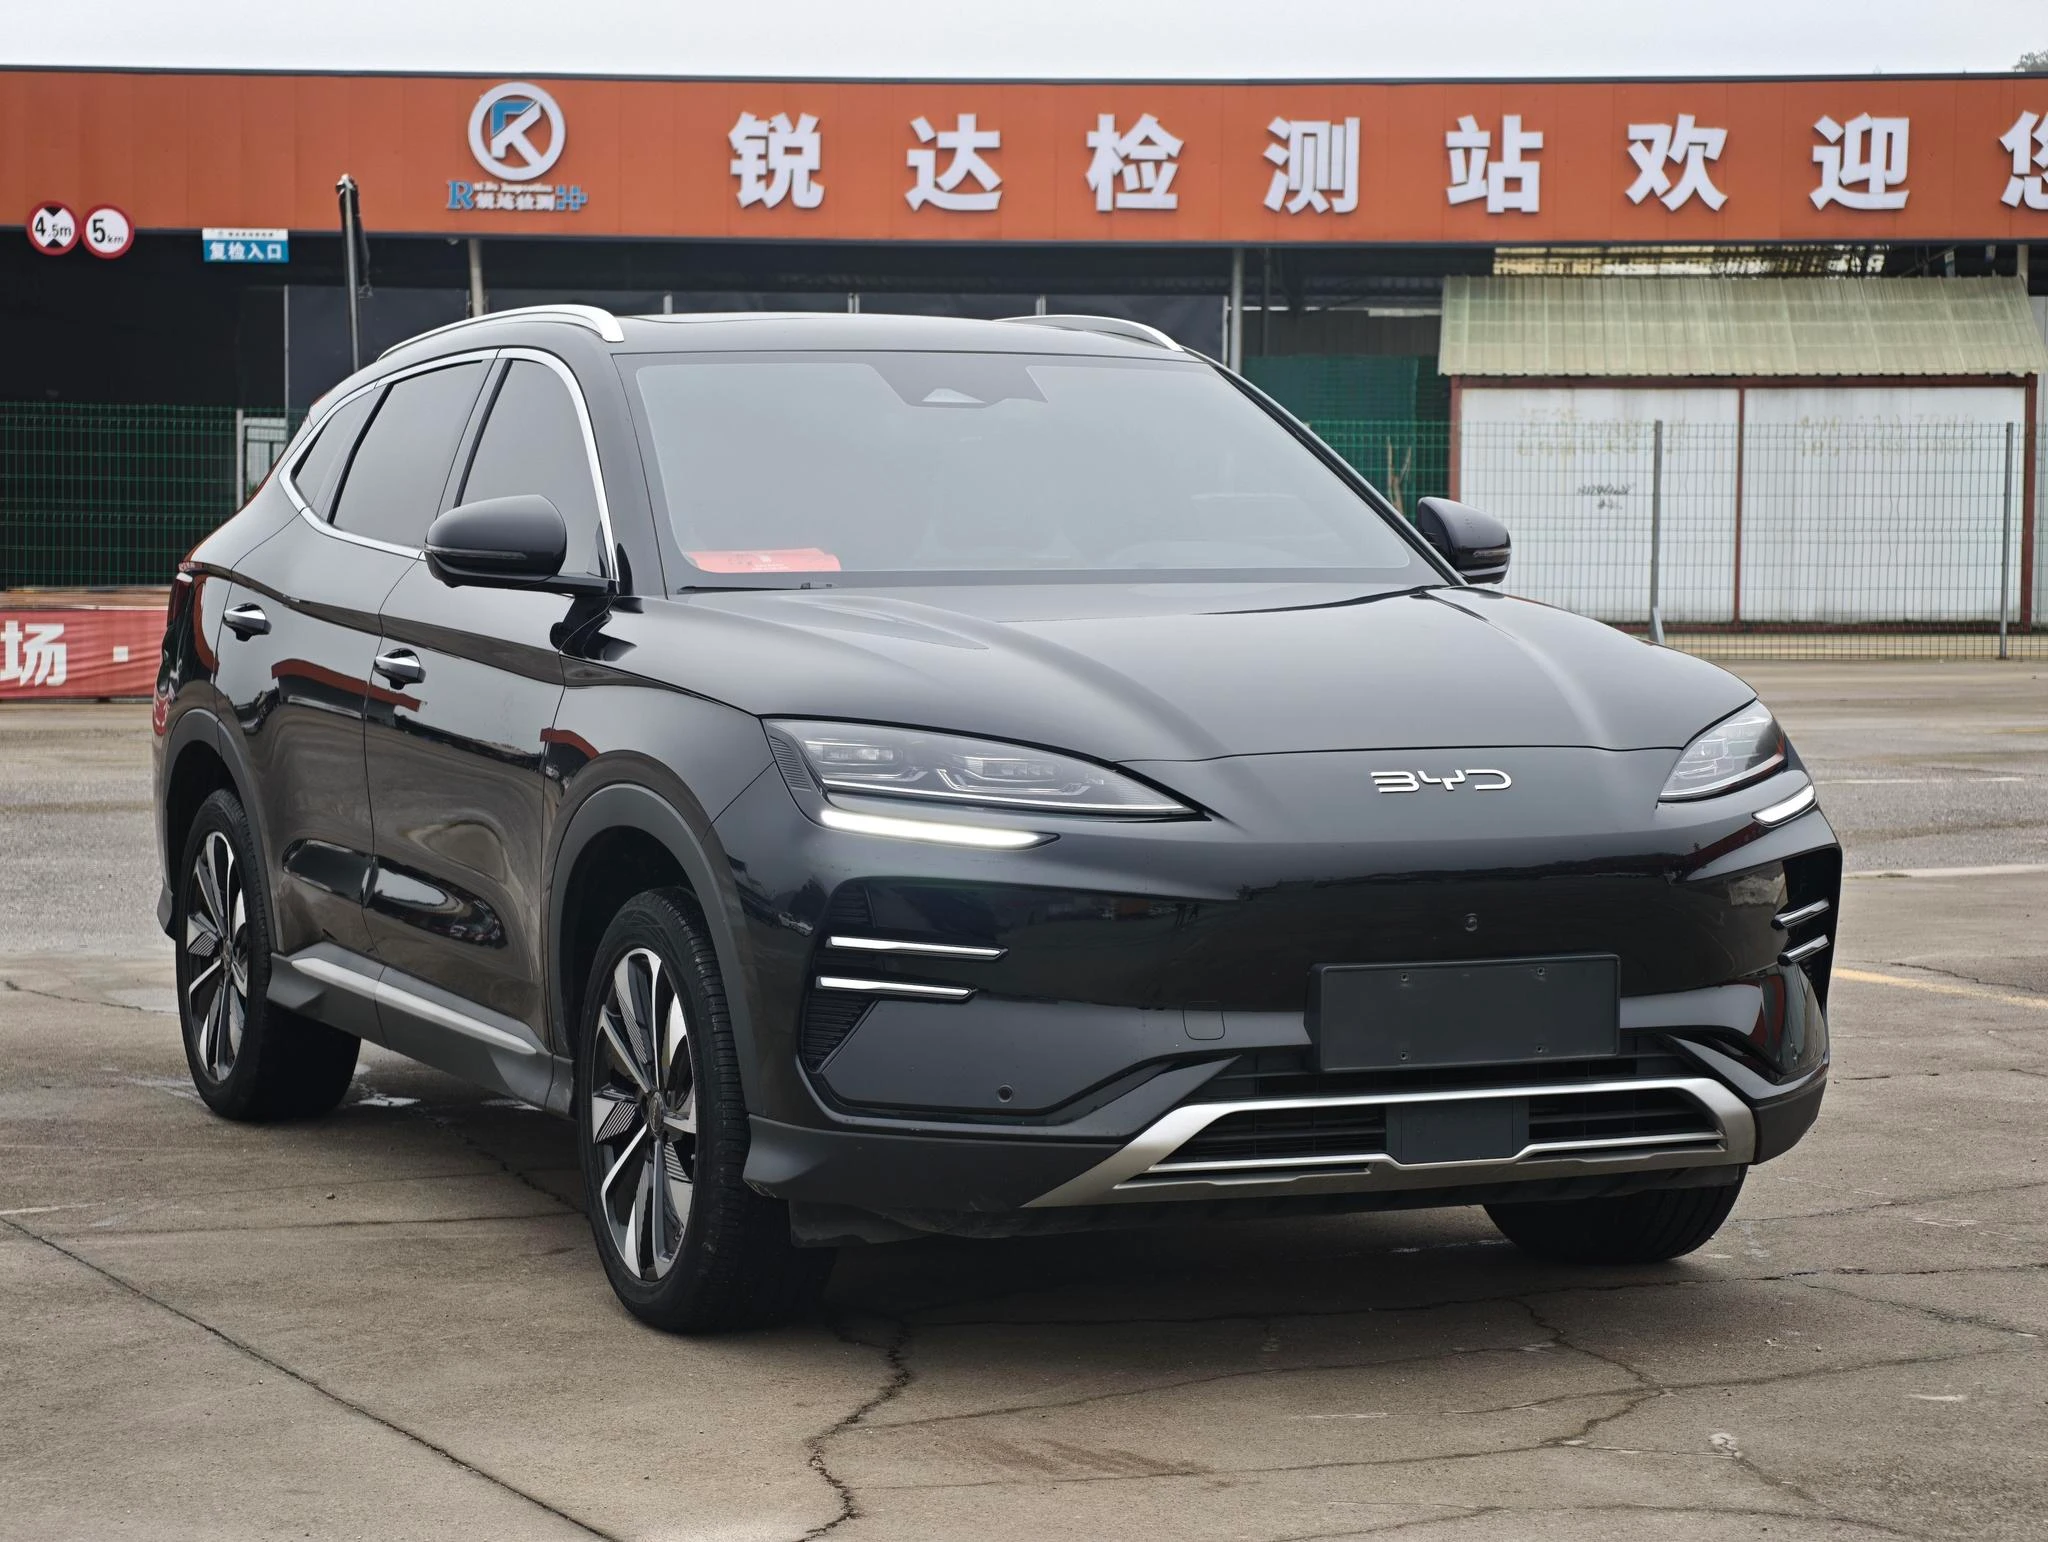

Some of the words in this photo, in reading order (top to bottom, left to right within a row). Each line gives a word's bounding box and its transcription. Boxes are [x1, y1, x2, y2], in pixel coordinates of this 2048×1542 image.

[209, 241, 283, 260] 复检入口
[1370, 768, 1513, 793] BYD
